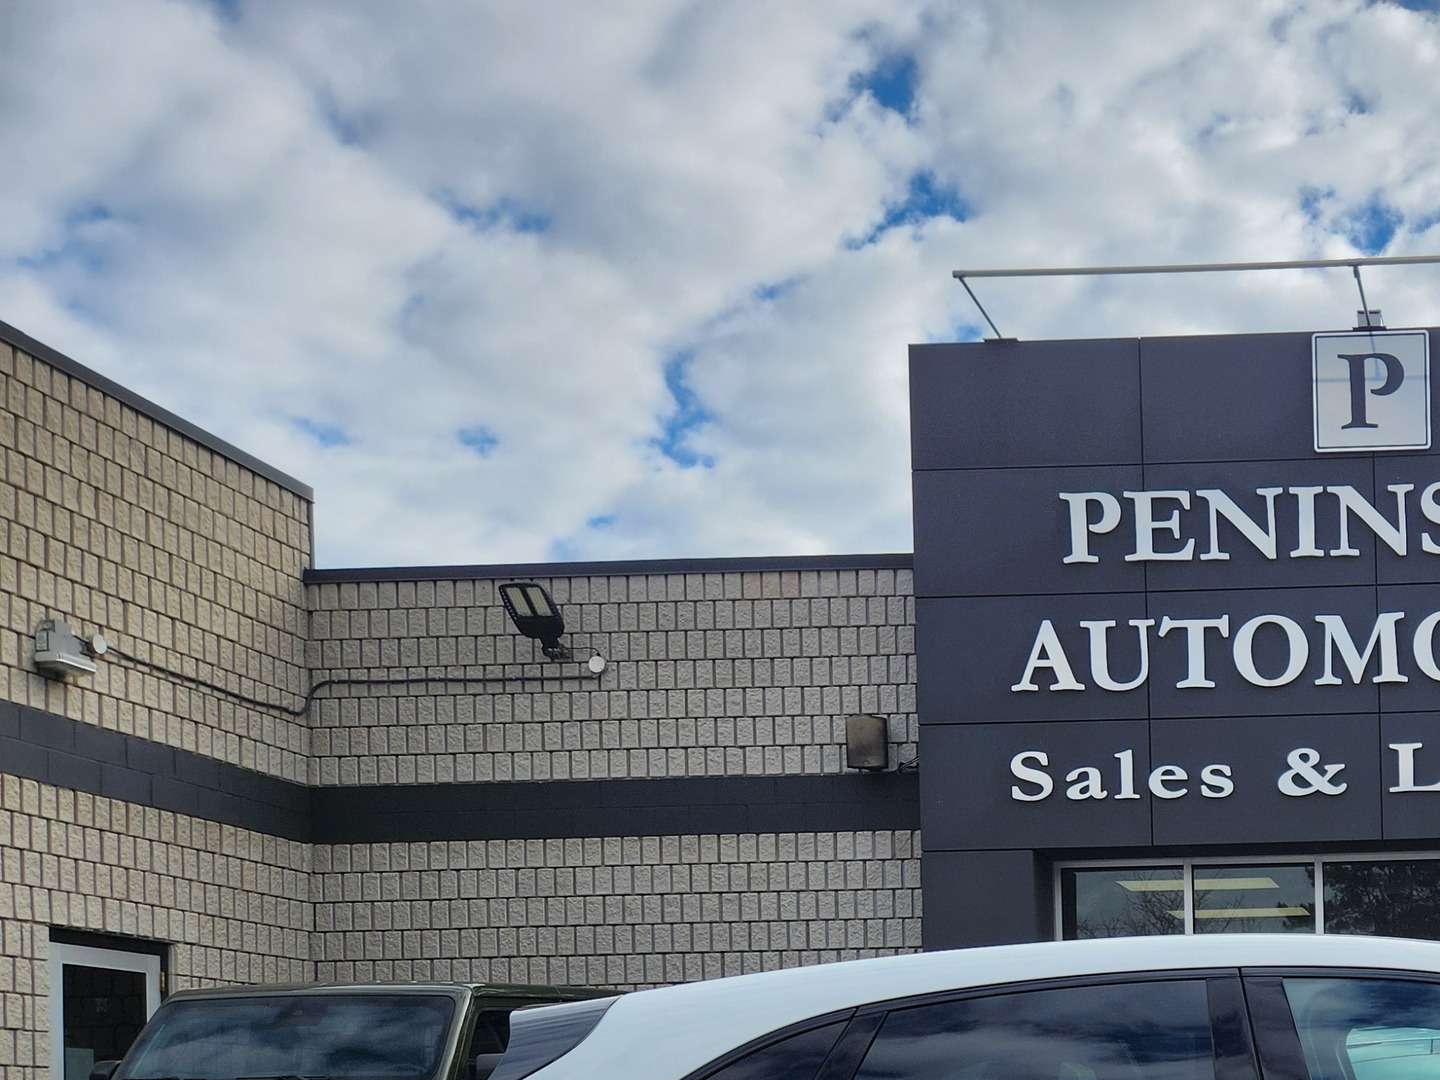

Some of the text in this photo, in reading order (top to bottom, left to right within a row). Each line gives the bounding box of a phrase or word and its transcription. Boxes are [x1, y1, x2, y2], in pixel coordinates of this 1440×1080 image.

[1337, 353, 1405, 429] P
[1010, 750, 1235, 802] Sales
[1277, 748, 1348, 797] &
